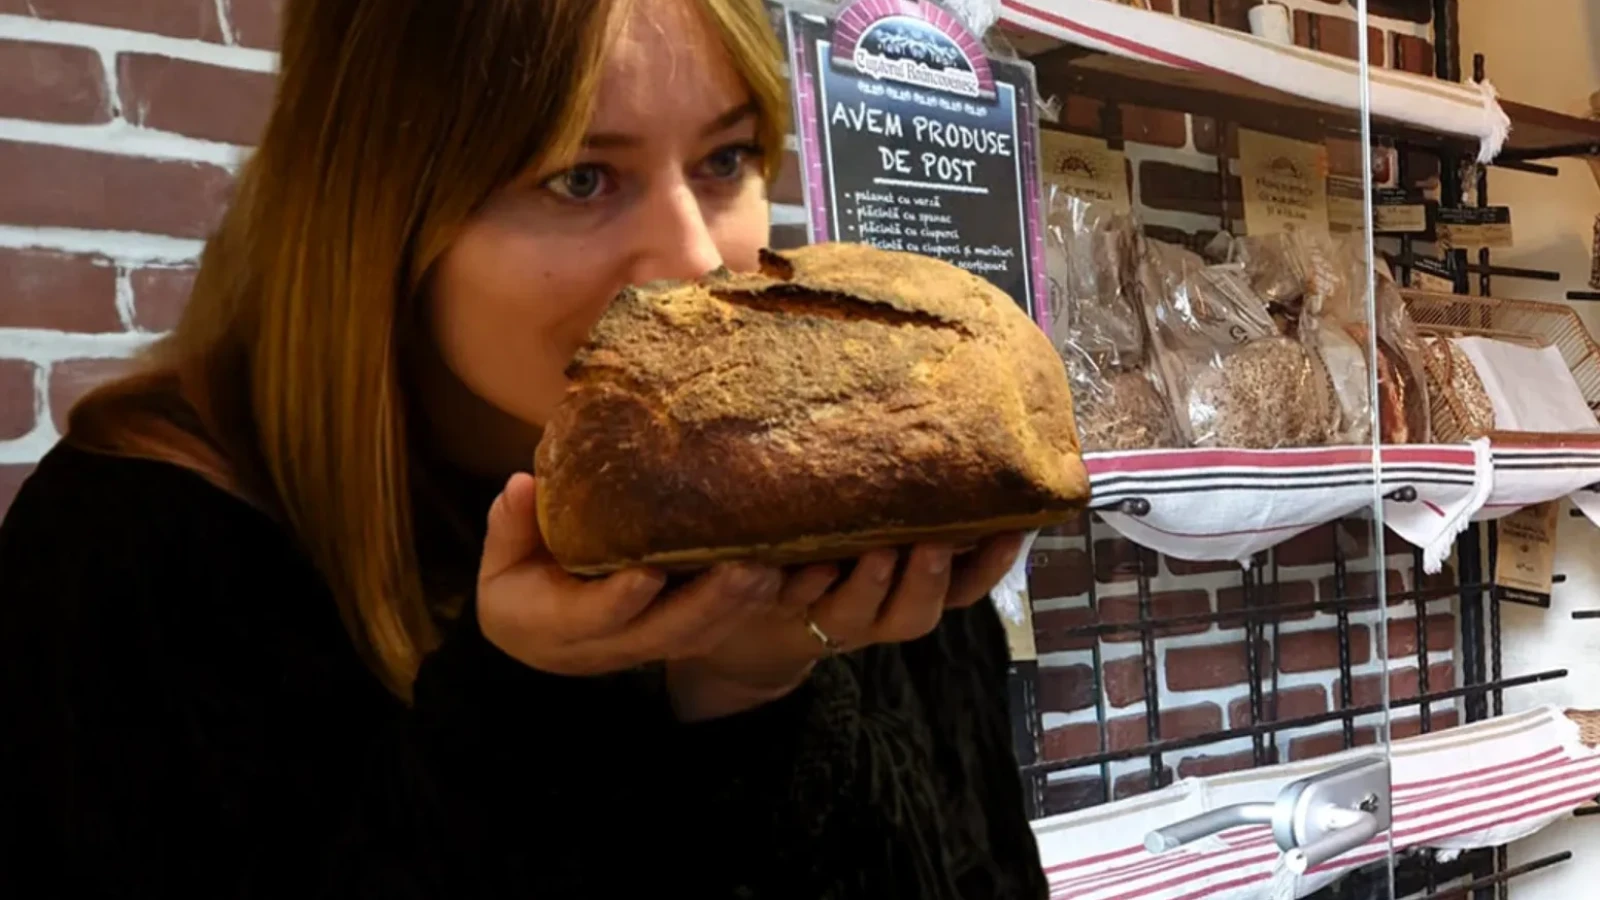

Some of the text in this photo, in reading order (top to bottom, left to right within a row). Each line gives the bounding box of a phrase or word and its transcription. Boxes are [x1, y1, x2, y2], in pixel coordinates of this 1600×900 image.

[832, 102, 1011, 156] AVEM PRODUSE
[878, 146, 977, 183] DE POST
[898, 195, 911, 205] cu
[857, 206, 899, 222] plăcintă
[903, 211, 916, 221] cu
[859, 222, 960, 243] plăcintă cu ciuperci
[906, 242, 920, 252] cu
[922, 242, 960, 258] ciuperci
